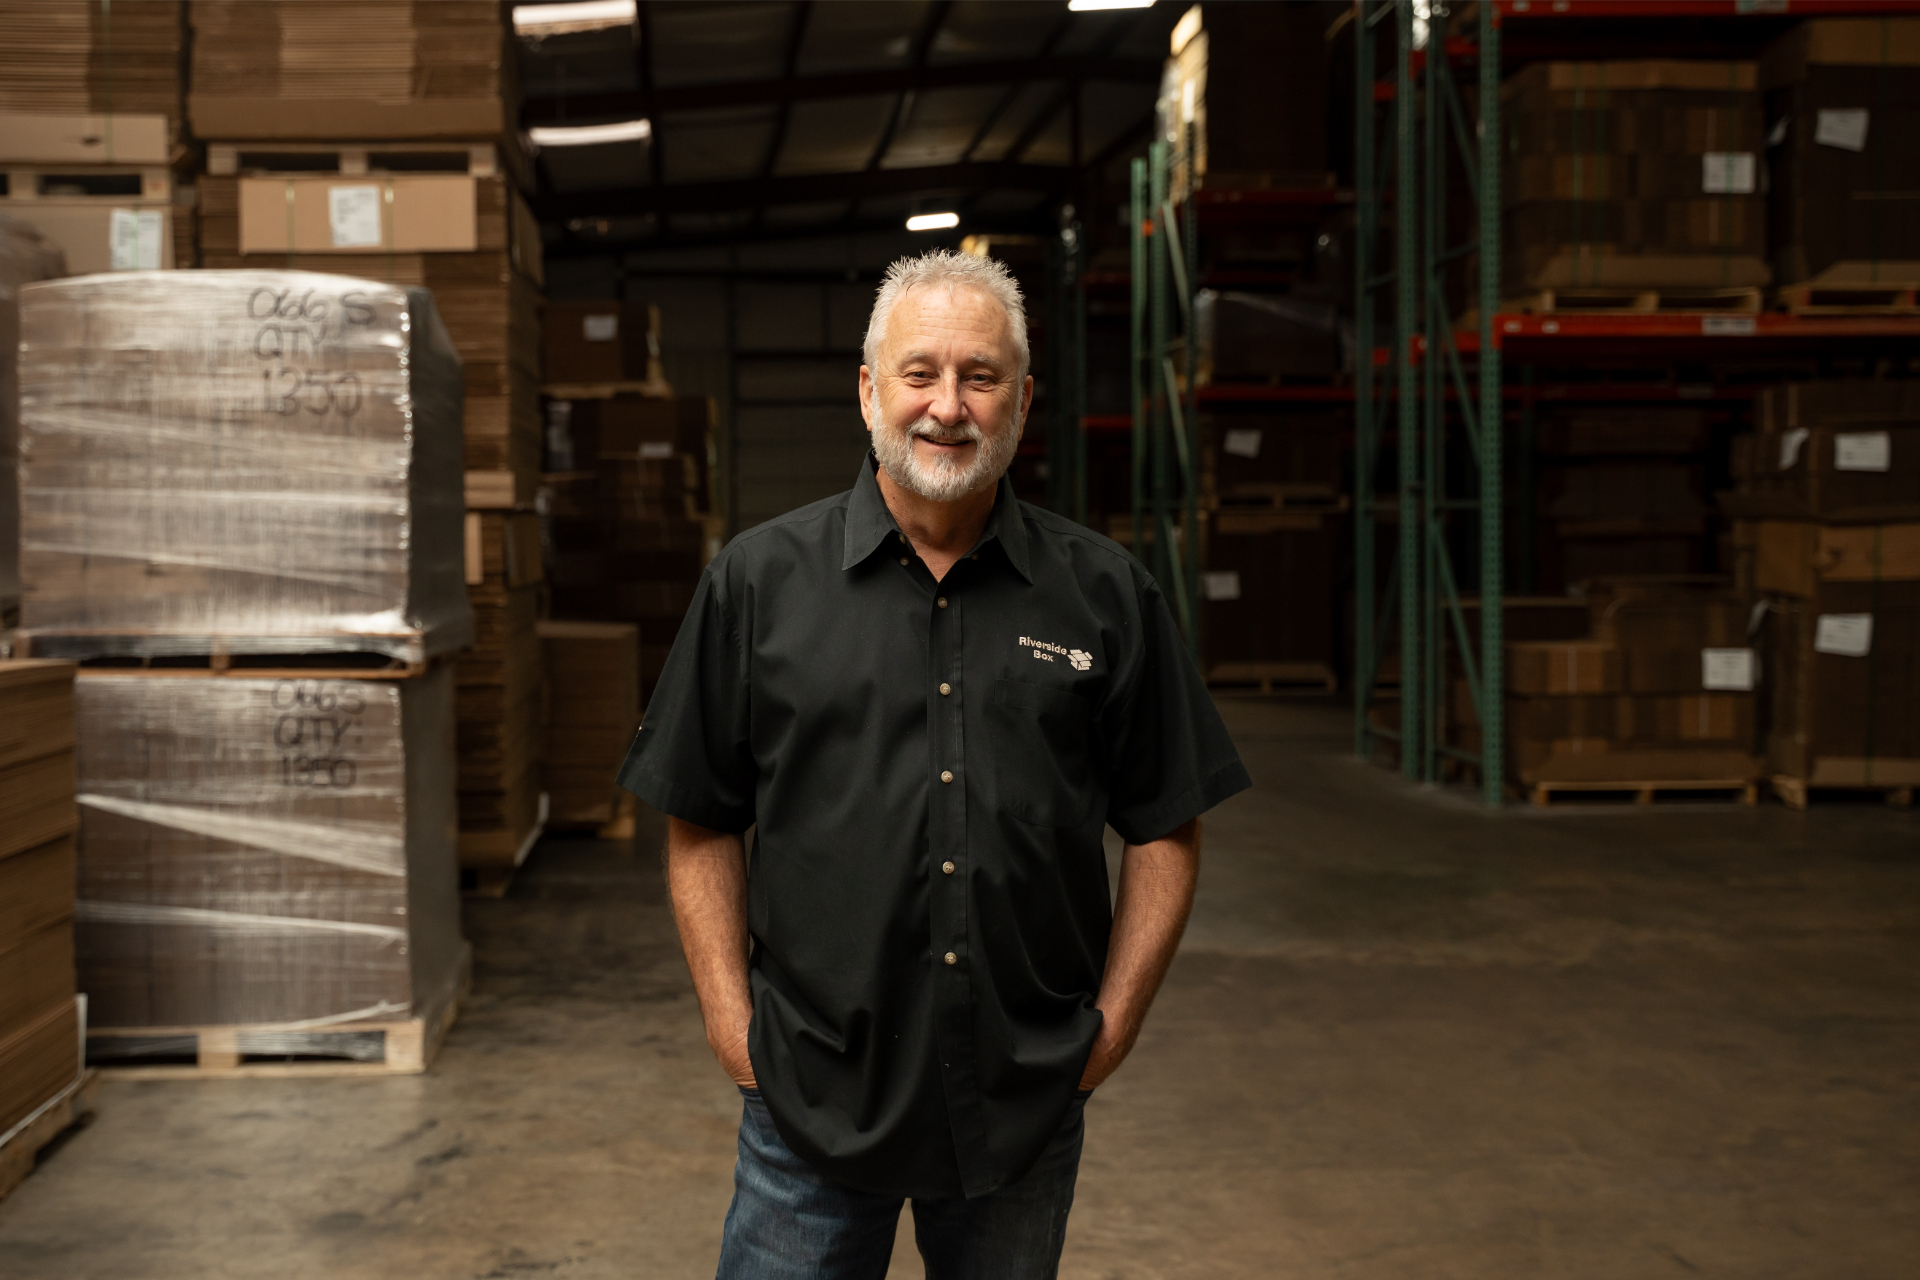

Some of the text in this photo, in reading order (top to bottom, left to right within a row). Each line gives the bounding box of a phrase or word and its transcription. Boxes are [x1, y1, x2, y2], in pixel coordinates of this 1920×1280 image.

[263, 367, 363, 417] 1350
[1018, 636, 1067, 656] Riverside
[1033, 649, 1054, 662] Box
